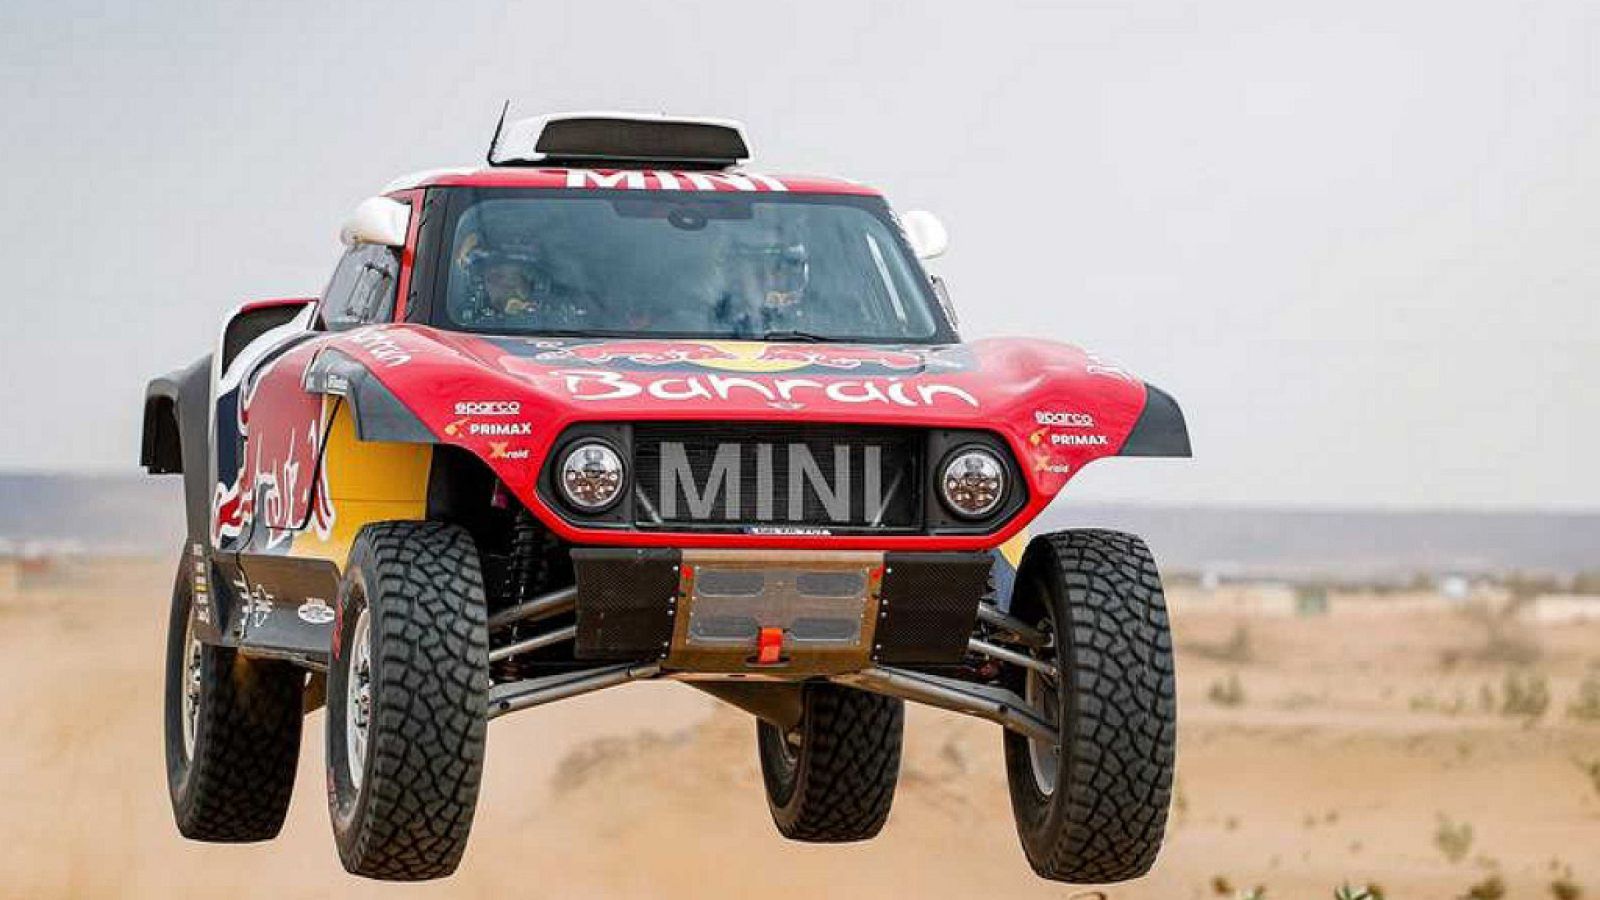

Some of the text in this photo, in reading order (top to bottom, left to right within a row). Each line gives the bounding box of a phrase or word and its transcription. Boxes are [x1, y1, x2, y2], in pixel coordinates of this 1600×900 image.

[566, 170, 789, 192] MINI
[550, 371, 979, 407] Bahrain
[455, 402, 520, 416] sparco
[1035, 411, 1095, 427] sparco
[470, 423, 532, 436] PRIMAX
[1051, 434, 1108, 446] PRIMAX
[659, 441, 882, 523] MINI
